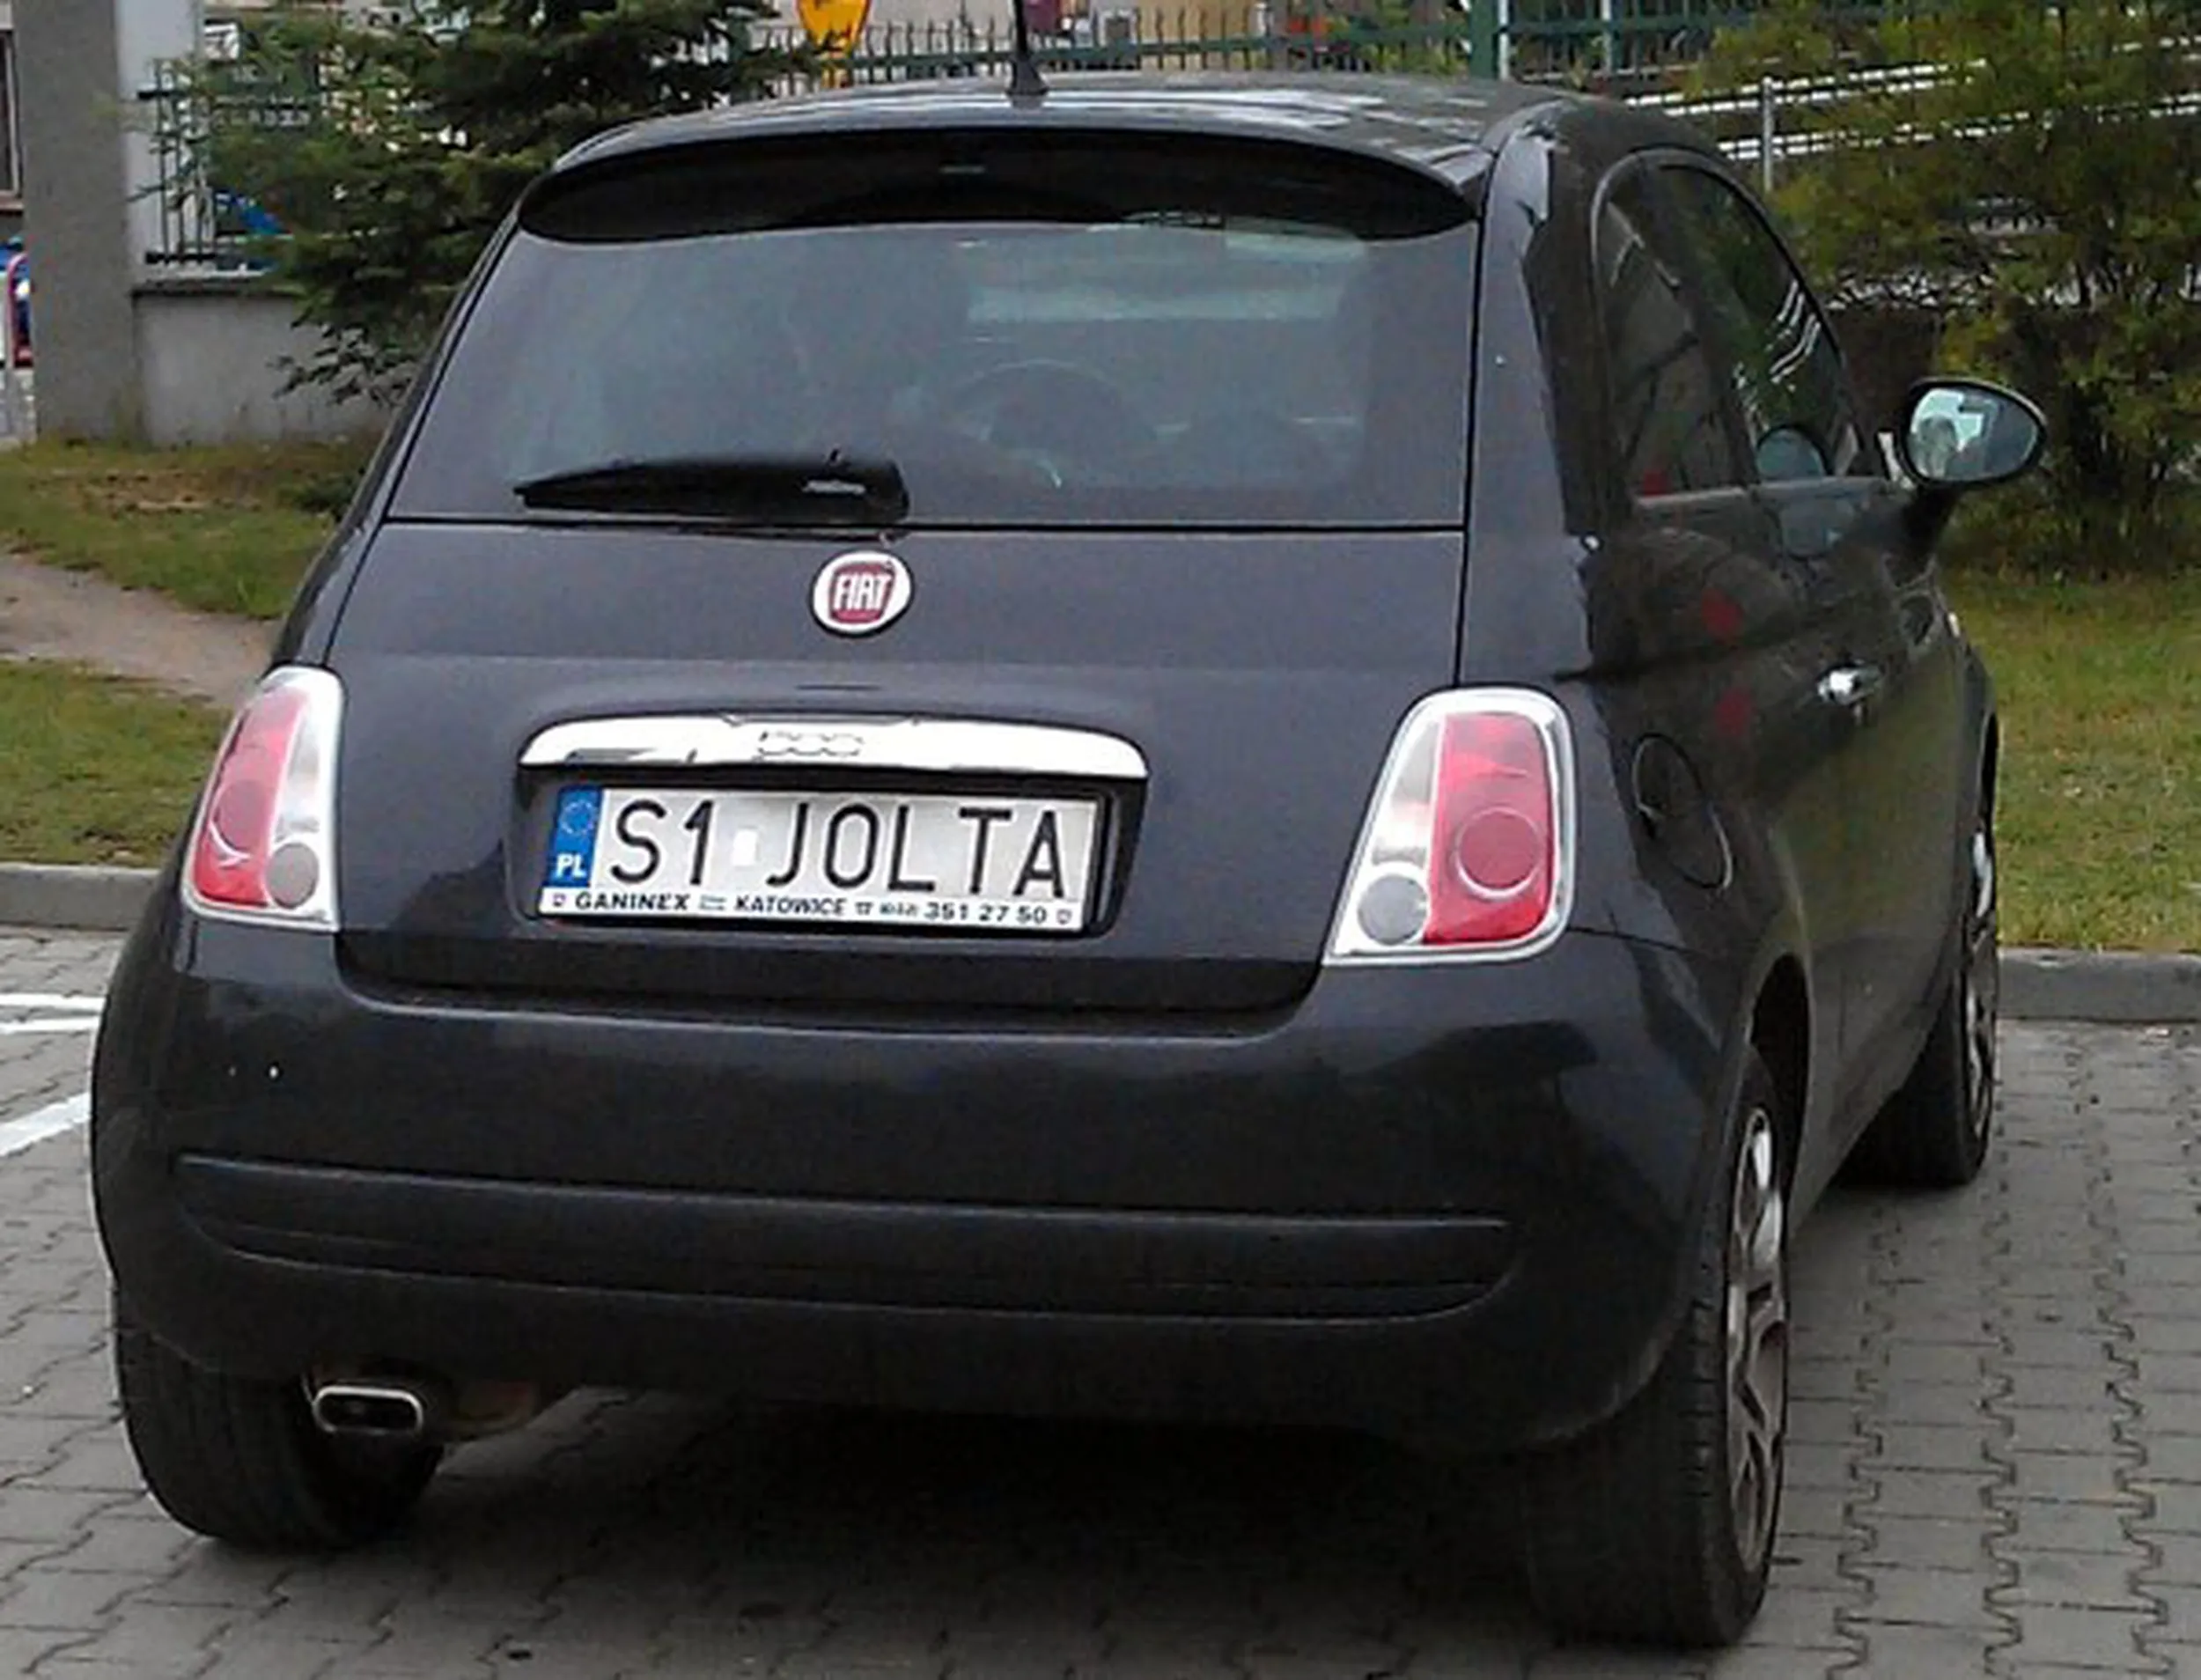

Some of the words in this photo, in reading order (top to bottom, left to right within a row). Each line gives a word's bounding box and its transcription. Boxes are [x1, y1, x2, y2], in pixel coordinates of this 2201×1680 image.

[833, 572, 893, 609] FIAT
[609, 799, 715, 886] S1
[556, 852, 586, 880] PL
[574, 891, 691, 912] GANINEX
[733, 895, 847, 917] KATOWICE
[924, 901, 969, 921] 351
[978, 903, 1011, 922] 27
[1016, 904, 1049, 925] 50
